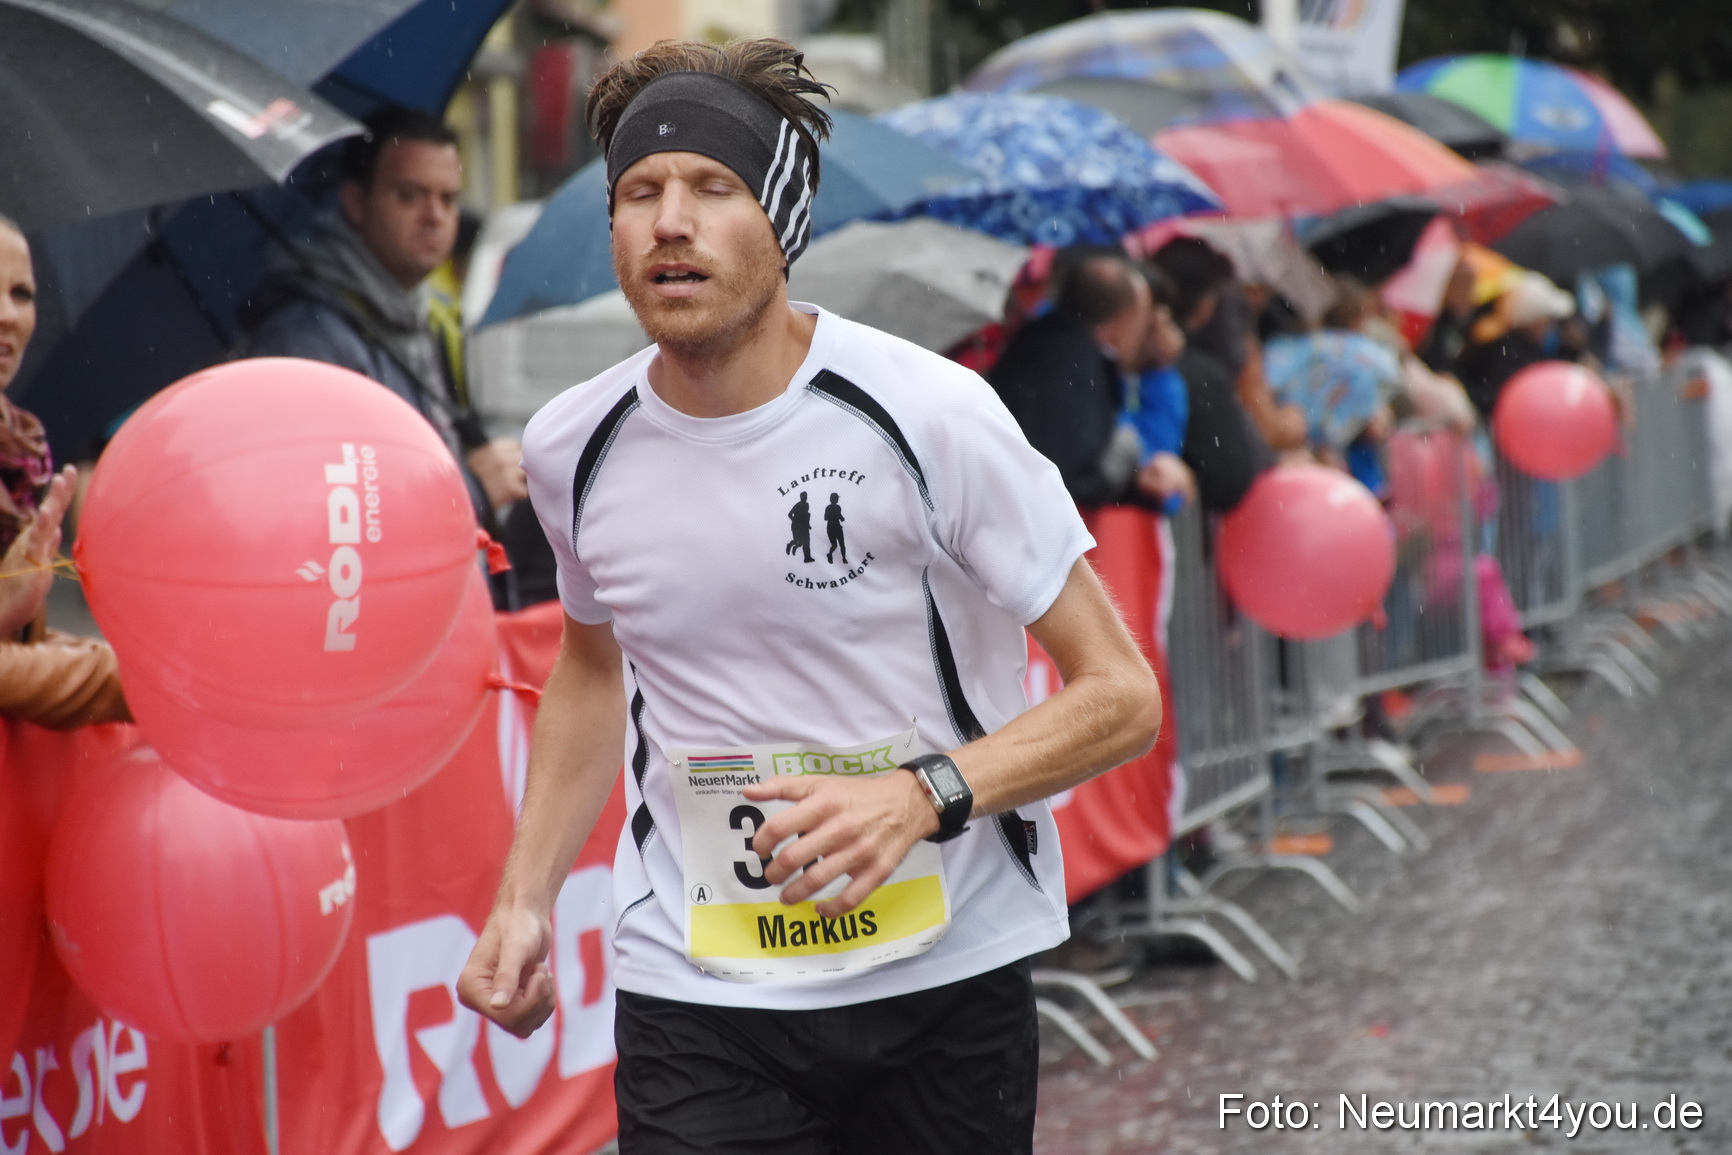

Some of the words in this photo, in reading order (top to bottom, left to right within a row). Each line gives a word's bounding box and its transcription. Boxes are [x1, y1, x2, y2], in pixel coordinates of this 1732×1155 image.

[777, 467, 866, 497] Lauftreff
[785, 551, 876, 590] Schwandorf
[772, 745, 899, 776] BOCK
[688, 774, 761, 787] NeuerMarkt
[696, 887, 707, 902] A
[757, 909, 878, 949] Markus
